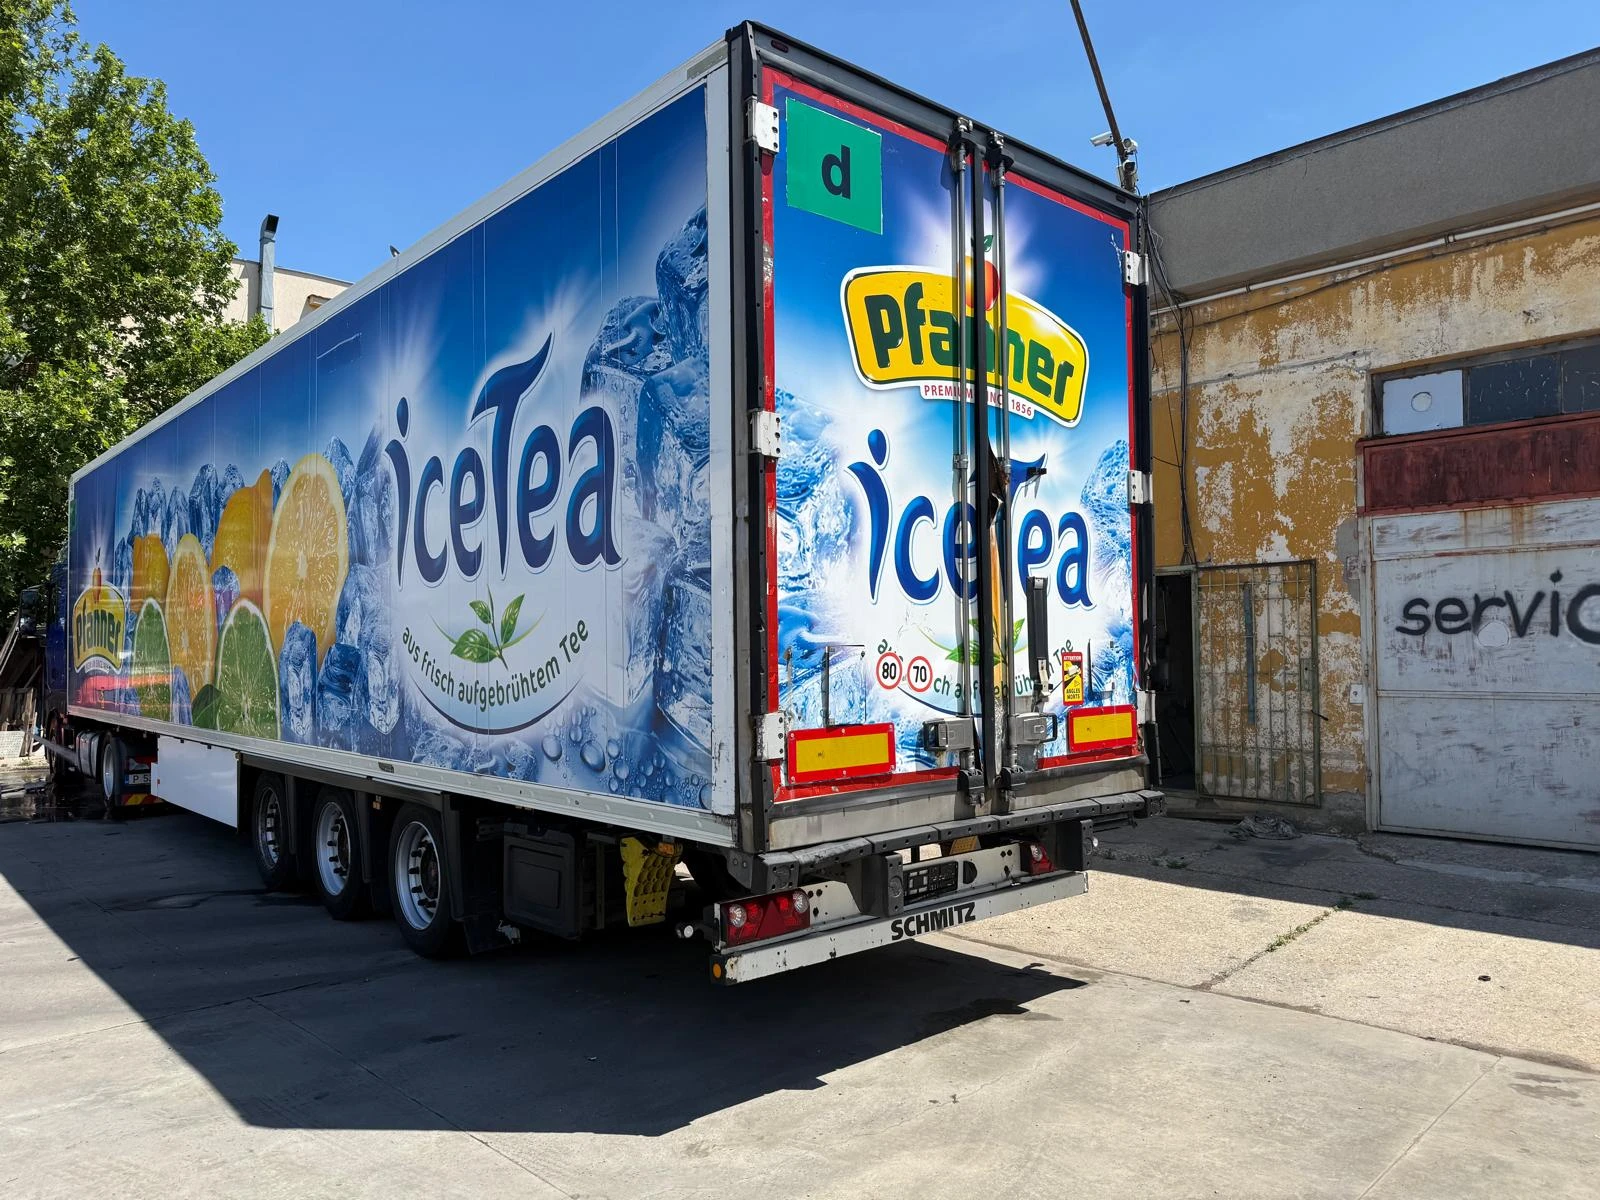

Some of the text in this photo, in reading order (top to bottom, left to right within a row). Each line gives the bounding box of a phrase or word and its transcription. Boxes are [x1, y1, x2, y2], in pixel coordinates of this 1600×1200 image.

[821, 145, 852, 200] d
[1011, 399, 1032, 416] 1856
[385, 332, 623, 588] iceTea
[402, 619, 589, 712] aus frisch aufgebrühtem Tee
[882, 662, 897, 680] 80
[913, 665, 927, 683] 70
[890, 902, 976, 940] SCHMITZ
